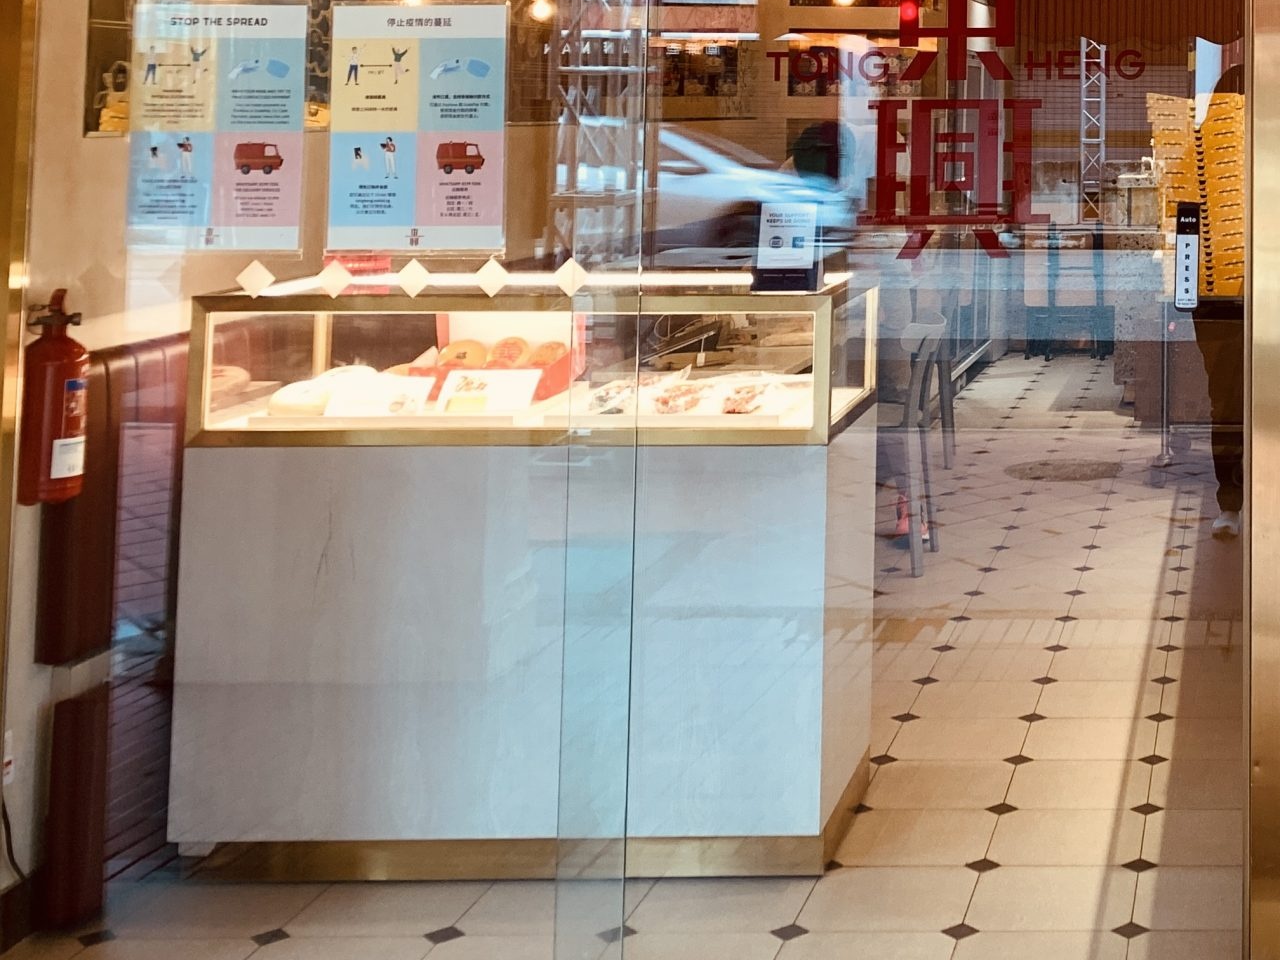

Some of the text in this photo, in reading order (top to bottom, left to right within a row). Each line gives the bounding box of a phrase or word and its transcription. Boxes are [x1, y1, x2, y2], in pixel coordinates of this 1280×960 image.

[170, 17, 268, 26] STOP THE SPREAD
[387, 17, 452, 27] 停止疫情的蔓延
[767, 49, 1146, 82] TONG HENG
